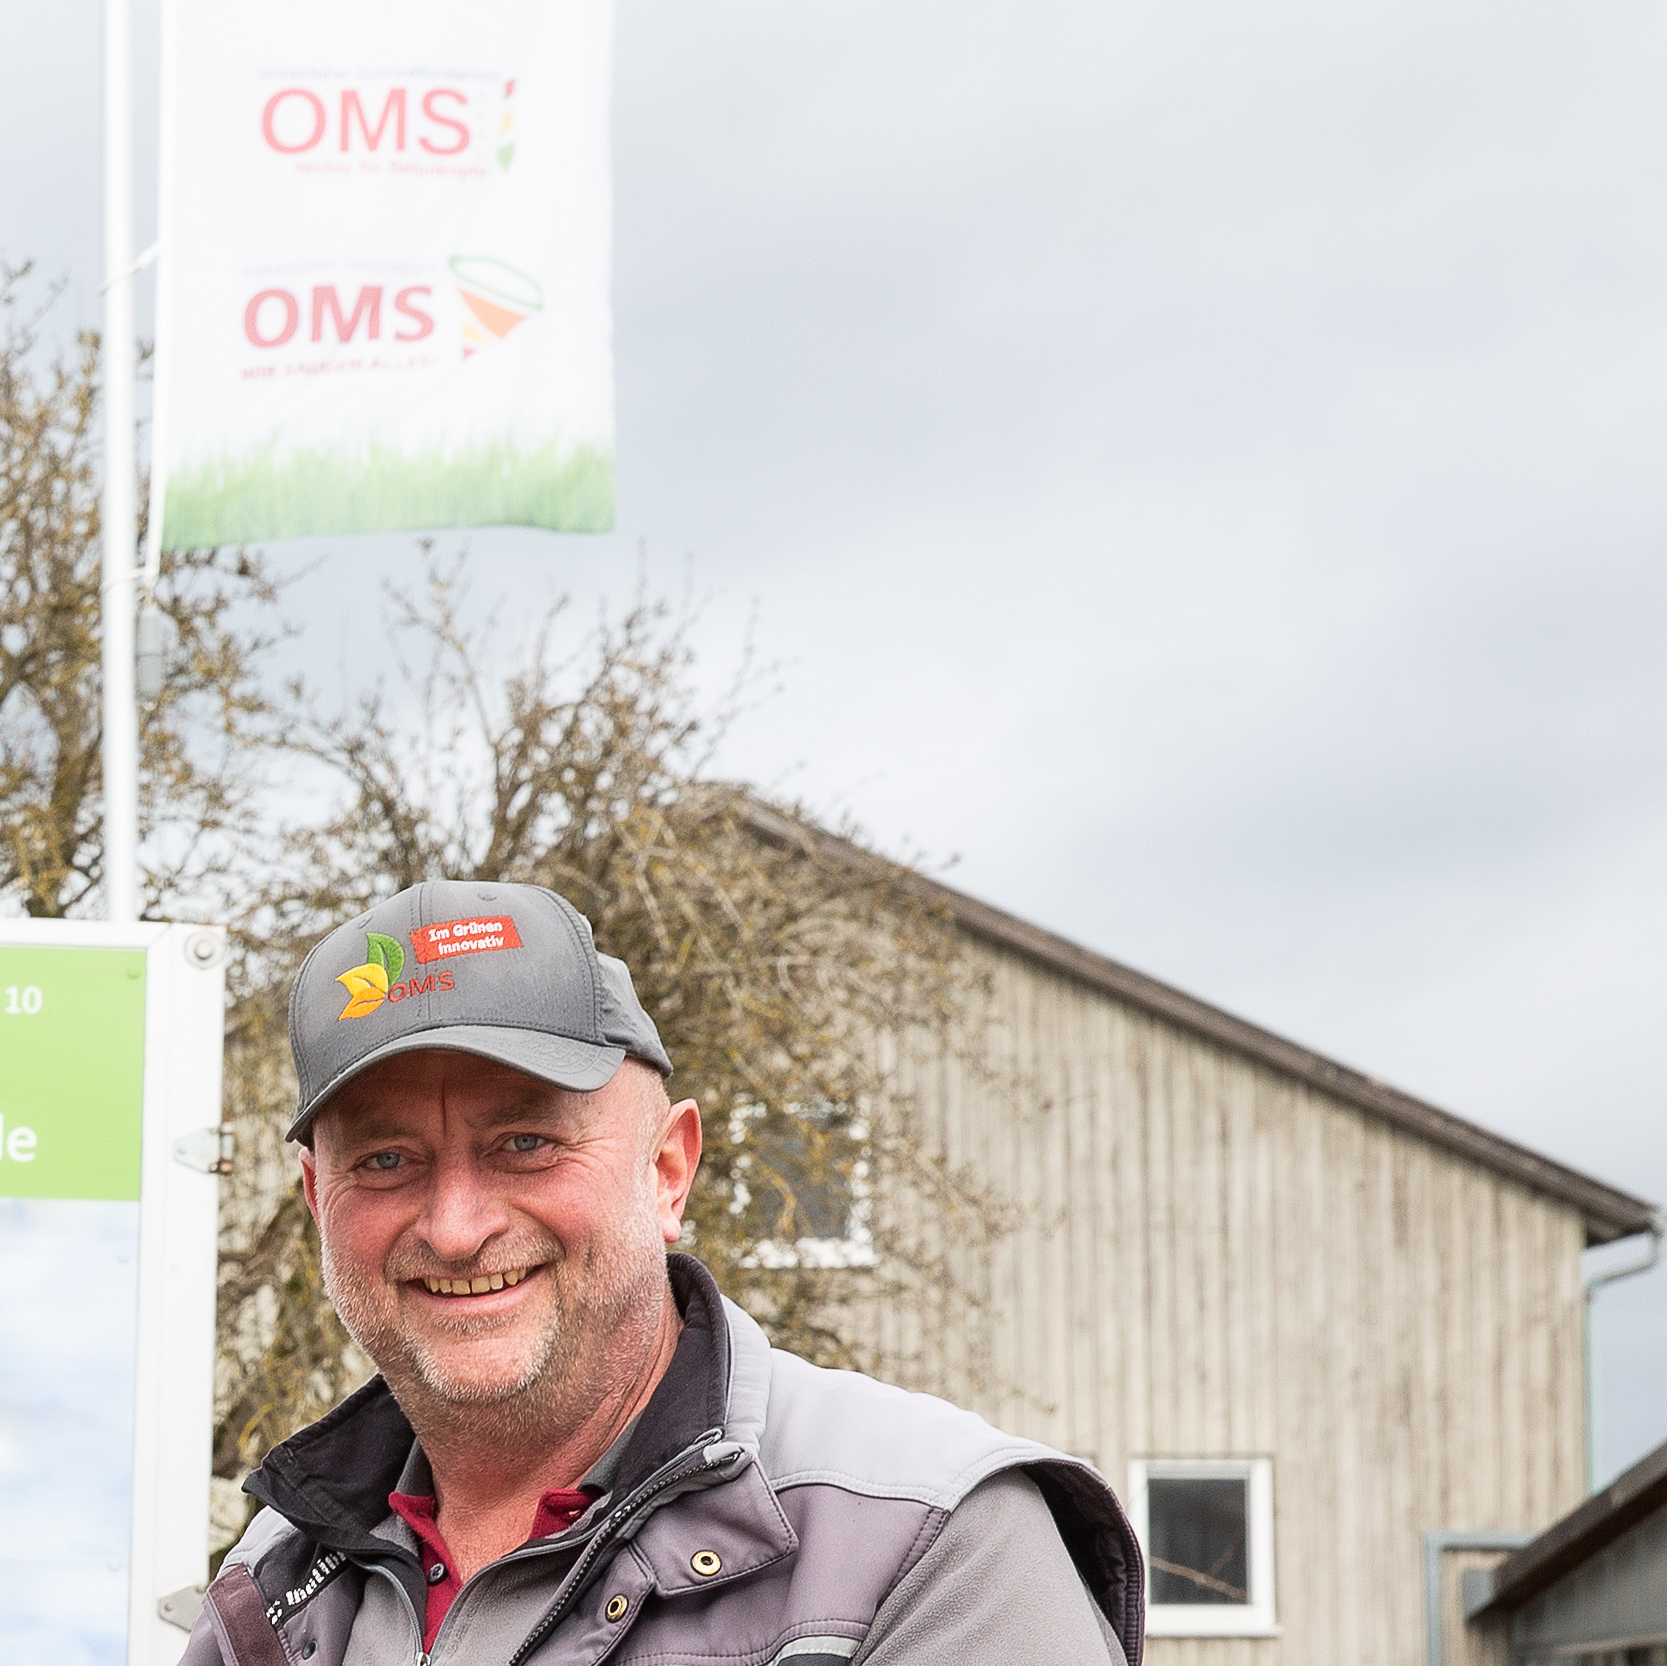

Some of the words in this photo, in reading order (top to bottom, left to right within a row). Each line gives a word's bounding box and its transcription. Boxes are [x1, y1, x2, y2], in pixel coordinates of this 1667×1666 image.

[261, 87, 471, 156] OMS
[243, 284, 435, 348] OMS
[428, 928, 450, 942] Im
[452, 921, 503, 937] Grünen
[438, 935, 504, 955] innovativ
[5, 985, 43, 1015] 10
[387, 971, 455, 1003] OMS
